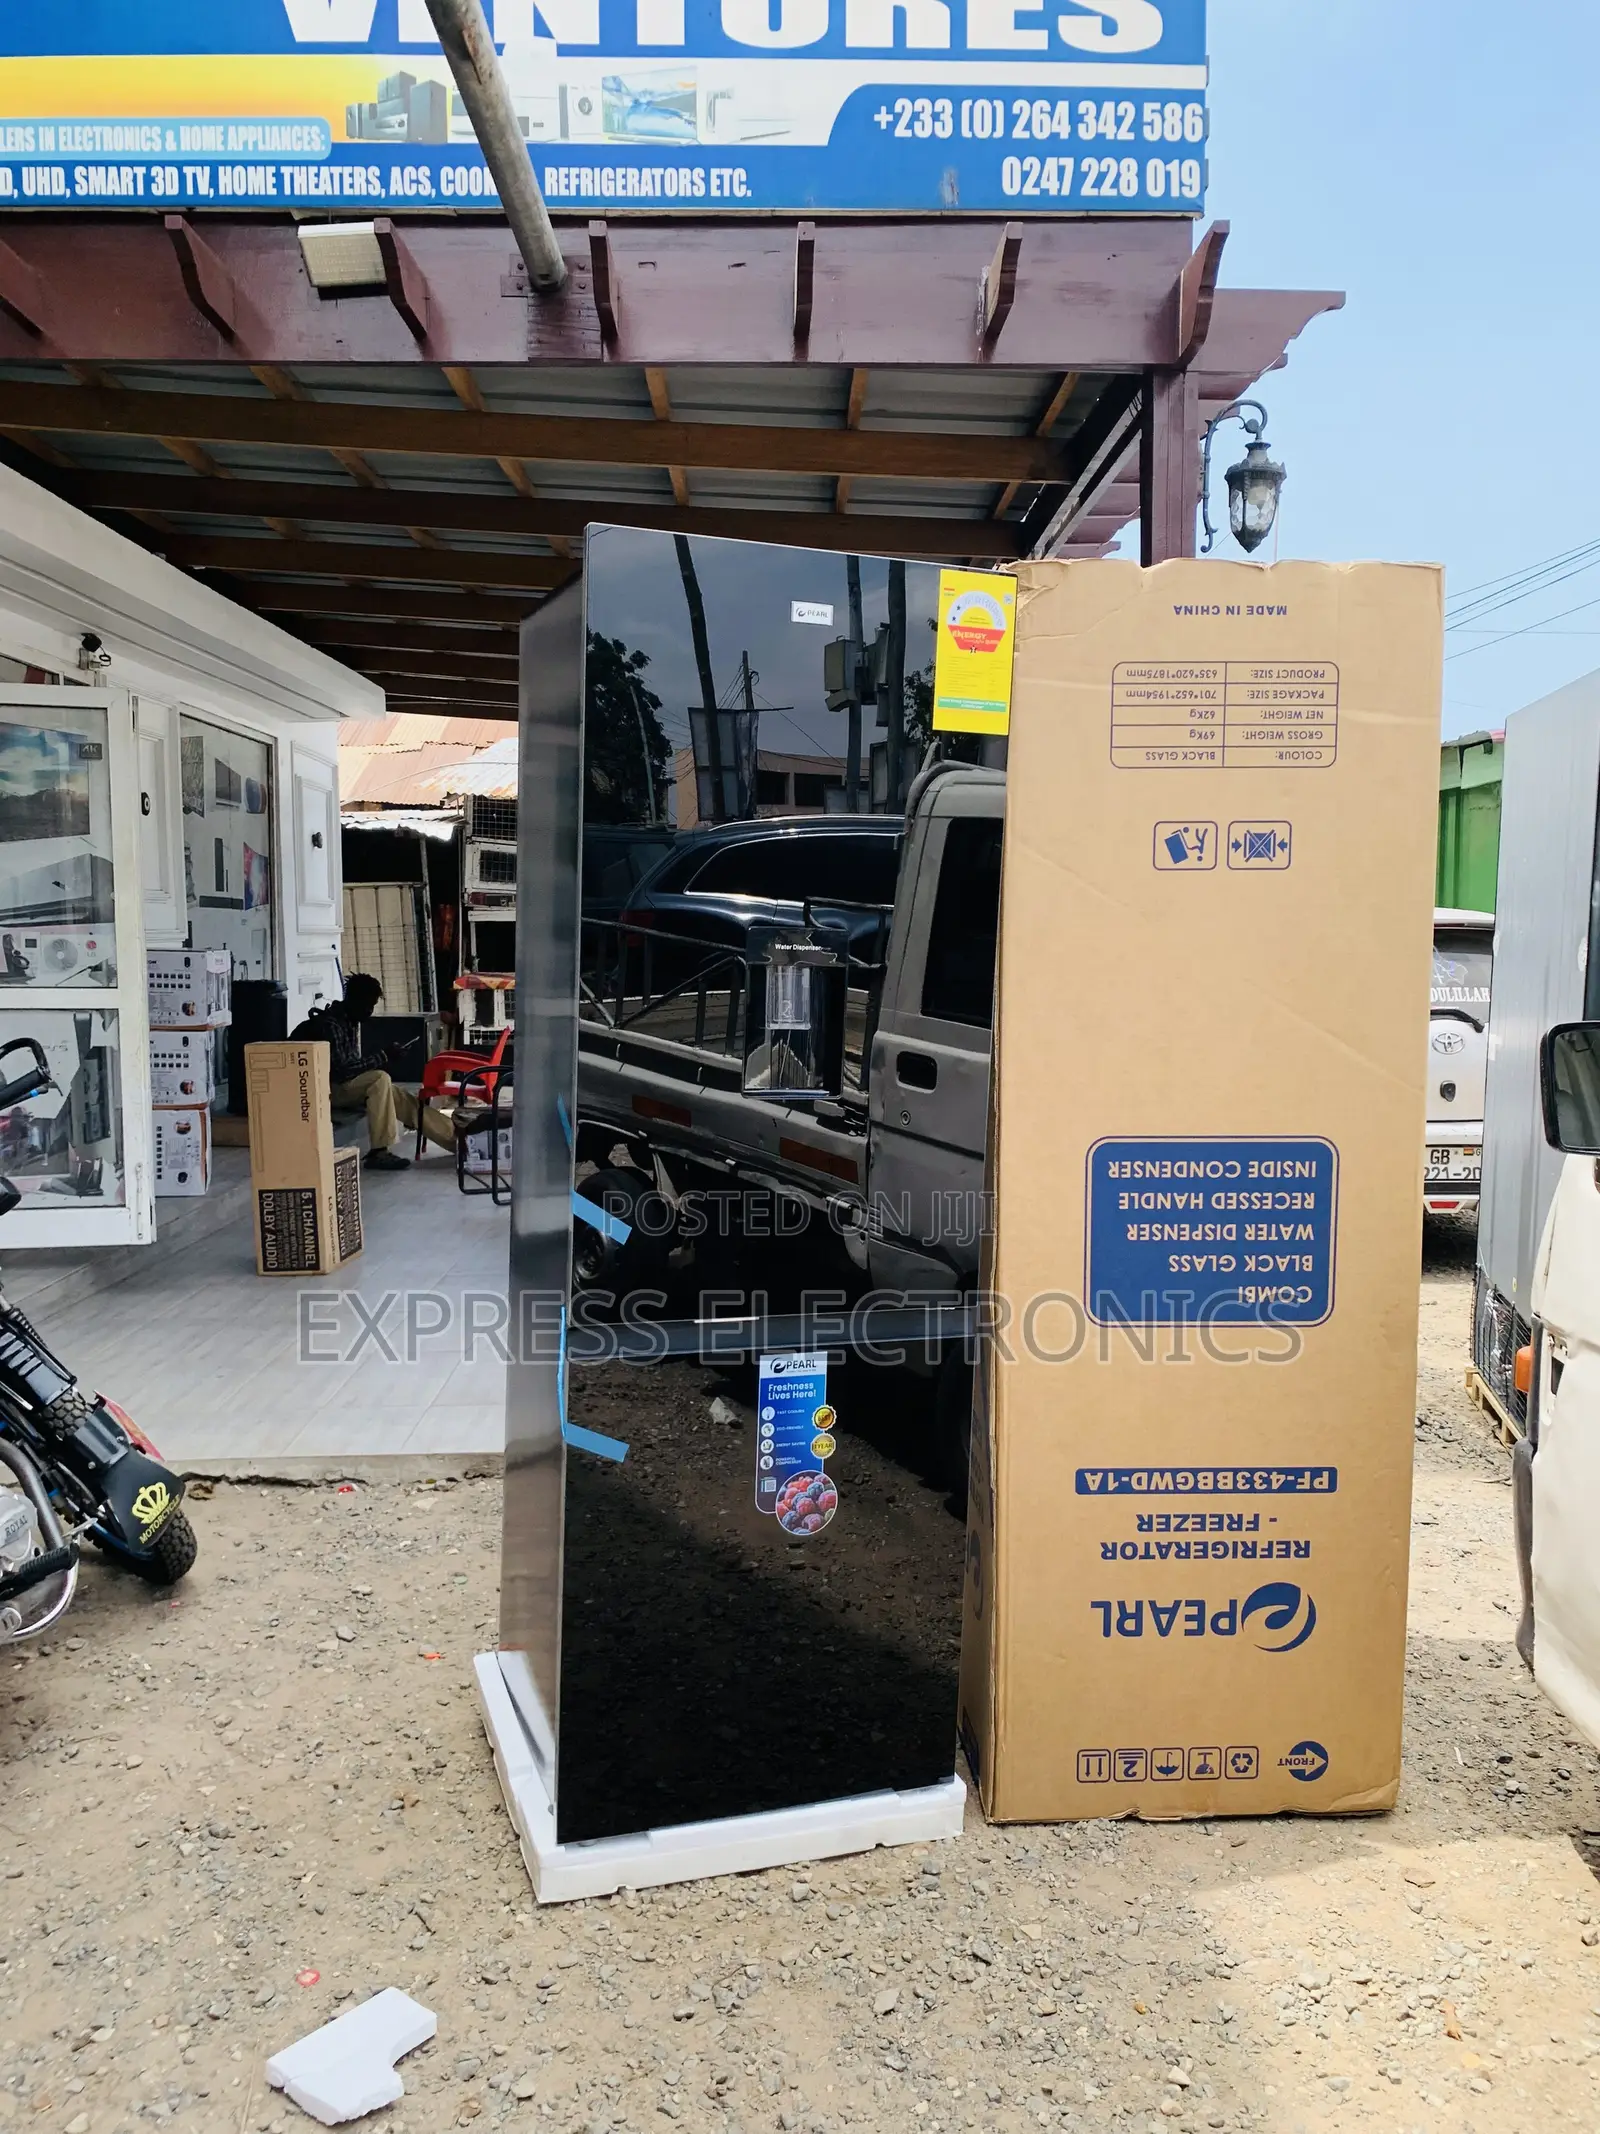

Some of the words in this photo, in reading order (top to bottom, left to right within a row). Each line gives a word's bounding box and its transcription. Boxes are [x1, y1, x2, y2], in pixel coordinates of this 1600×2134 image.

[873, 98, 953, 139] +233
[961, 99, 1004, 139] (0)
[1012, 100, 1071, 139] 264
[1078, 100, 1135, 141] 342
[1142, 102, 1203, 143] 586
[38, 126, 55, 152] IN
[59, 126, 162, 152] ELECTRONICS
[165, 129, 177, 152] &
[180, 125, 224, 152] HOME
[227, 125, 326, 152] APPLIANCES:
[21, 166, 71, 199] UHD,
[74, 165, 147, 197] SMART
[151, 165, 179, 197] 3D
[182, 166, 214, 198] TV,
[218, 165, 276, 196] HOME
[280, 166, 386, 198] THEATERS,
[389, 166, 436, 198] ACS,
[544, 167, 704, 197] REFRIGERATORS
[710, 168, 752, 197] ETC.
[1002, 156, 1074, 196] 0247
[1081, 157, 1139, 197] 228
[1146, 159, 1200, 198] 019
[807, 609, 829, 618] PEARL
[1173, 605, 1220, 616] CHINA
[1225, 605, 1241, 616] IN
[1245, 605, 1288, 616] MADE
[1250, 669, 1275, 679] SIZE:
[1276, 669, 1325, 679] PRODUCT
[1246, 689, 1271, 699] SIZE:
[1273, 689, 1325, 699] PACKAGE
[1189, 708, 1216, 720] 62Kg
[1260, 709, 1304, 719] WEIGHT:
[1305, 709, 1324, 719] NET
[1189, 728, 1216, 740] 69Kg
[1242, 729, 1284, 740] WEIGHT:
[1287, 729, 1323, 740] GROSS
[1145, 751, 1178, 761] GLASS
[1182, 751, 1216, 761] BLACK
[1275, 750, 1323, 760] COLOUR:
[298, 1051, 308, 1067] LG
[299, 1070, 311, 1123] Soundbar
[1430, 1149, 1450, 1165] GB
[1108, 1161, 1241, 1179] CONDENSER
[1248, 1161, 1316, 1178] INSIDE
[1119, 1192, 1204, 1209] HANDLE
[1211, 1192, 1315, 1209] RECESSED
[263, 1193, 275, 1230] DOLBY
[1126, 1224, 1236, 1240] DISPENSER
[1244, 1224, 1314, 1240] WATER
[265, 1233, 278, 1268] AUDIO
[1168, 1254, 1236, 1272] GLASS
[1244, 1254, 1313, 1272] BLACK
[1238, 1286, 1312, 1303] COMBI
[786, 1359, 817, 1370] PEARL
[768, 1382, 814, 1391] Freshness
[768, 1392, 791, 1400] Lives
[792, 1389, 817, 1399] Here!
[1084, 1472, 1330, 1490] PF-433BBGWD-1A
[1136, 1513, 1260, 1532] FREEZER
[1100, 1540, 1311, 1560] REFRIGERATOR
[1090, 1599, 1238, 1638] PEARL
[1277, 1757, 1315, 1766] FRONT
